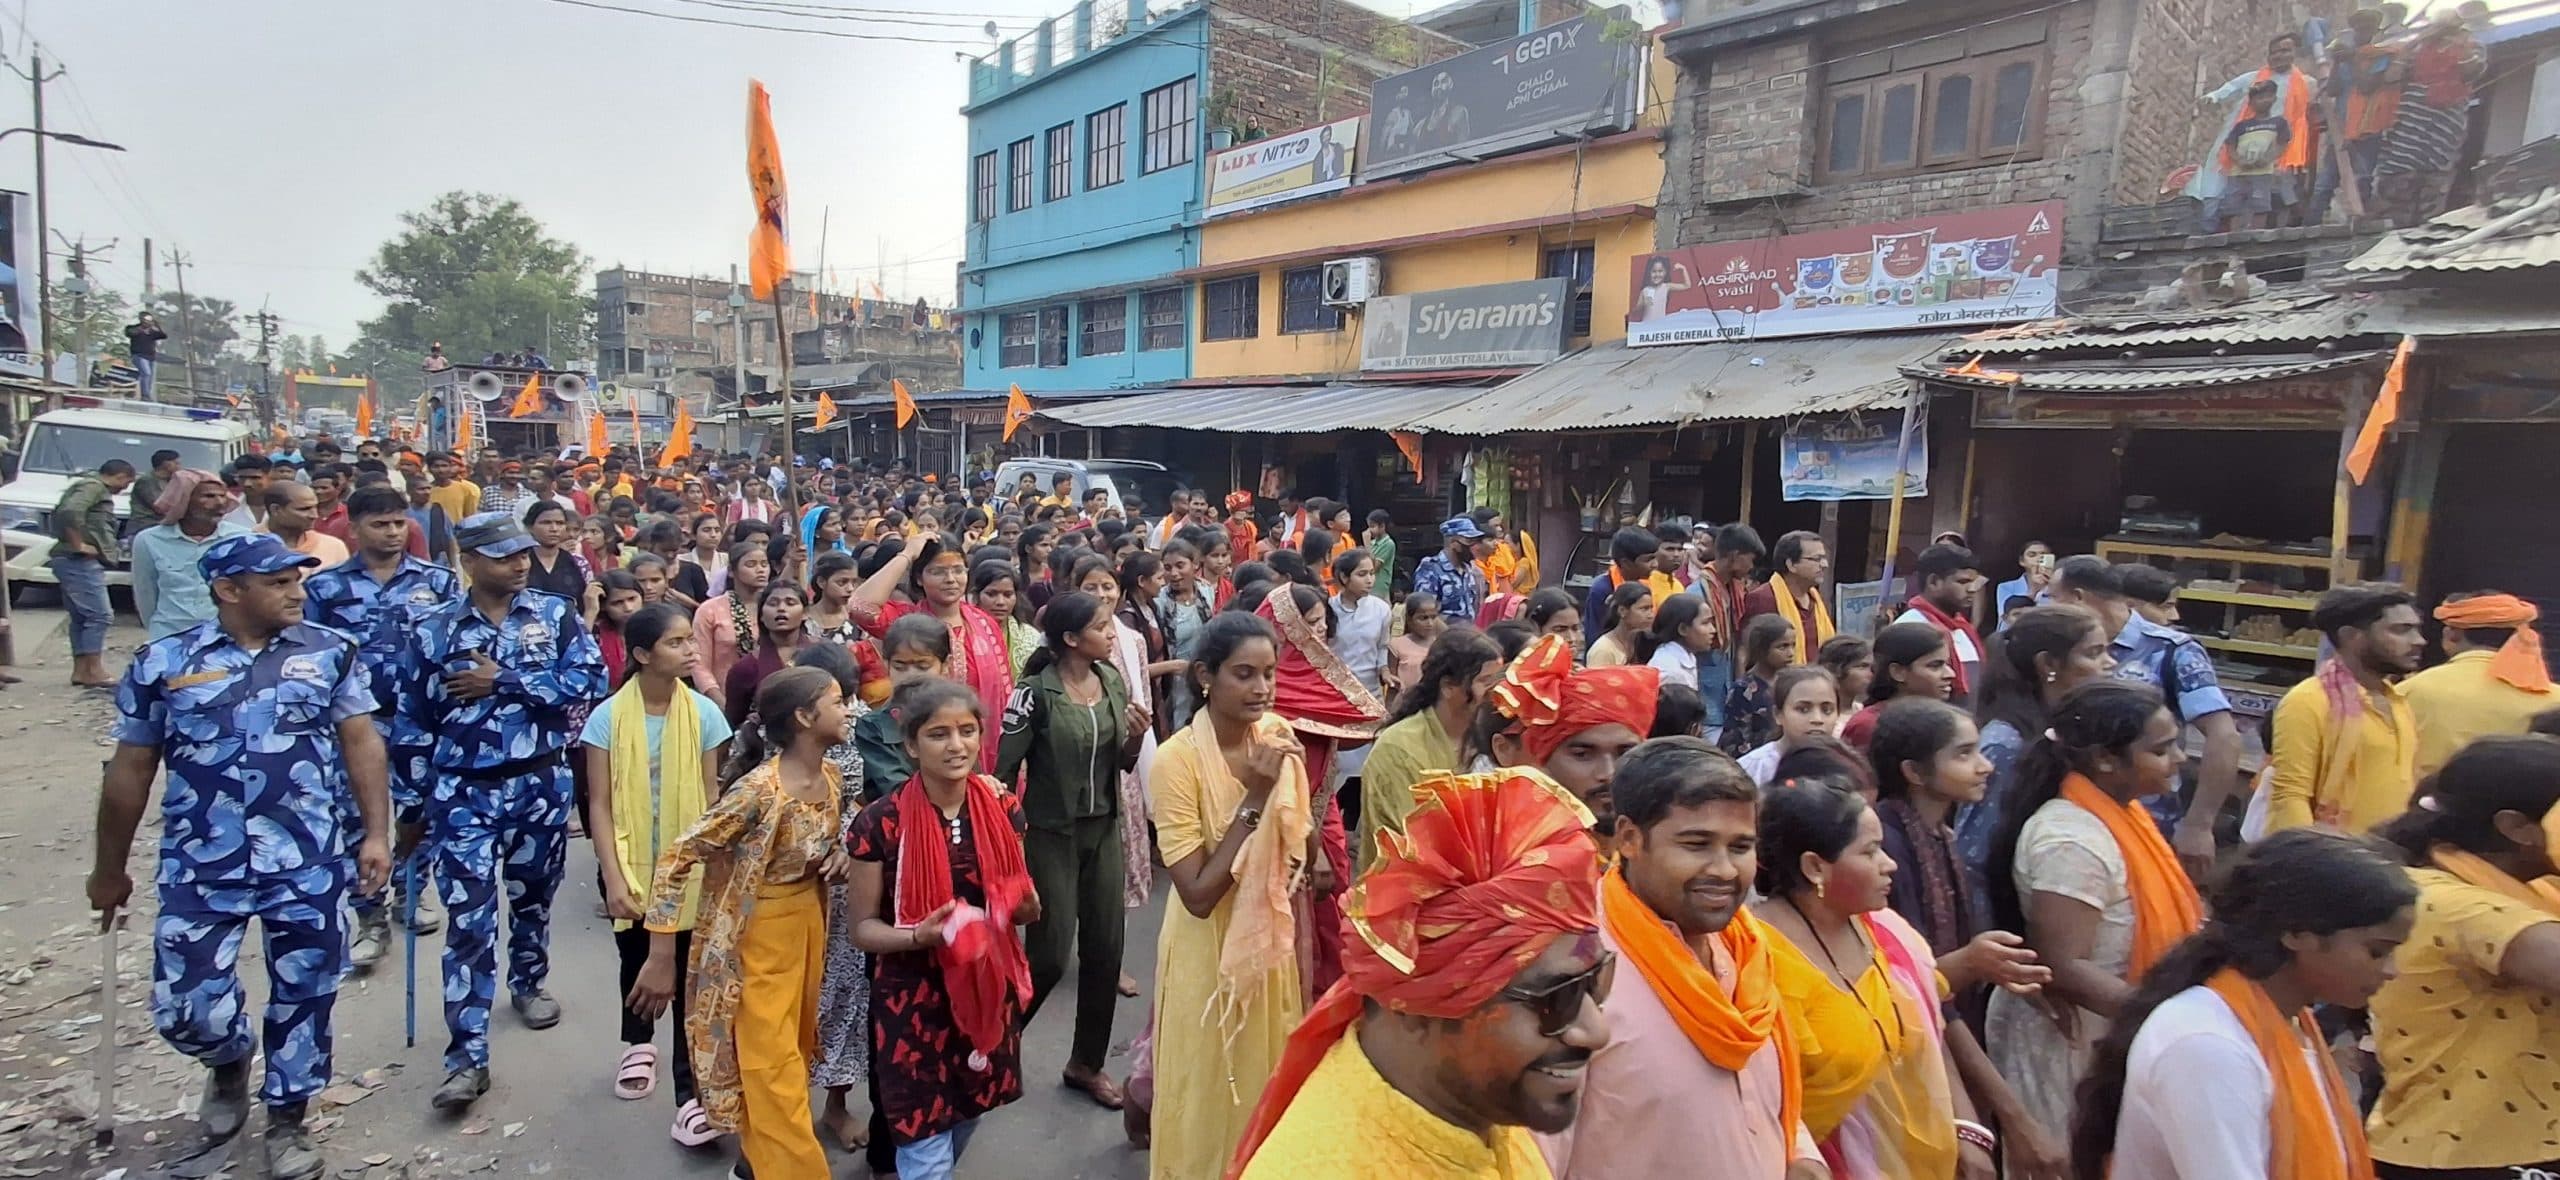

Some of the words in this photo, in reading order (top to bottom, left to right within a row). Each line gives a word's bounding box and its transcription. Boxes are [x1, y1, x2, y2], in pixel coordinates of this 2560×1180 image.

[1517, 69, 1554, 94] CHALO
[1505, 91, 1531, 112] APNI
[1532, 76, 1569, 100] CHAAL
[1221, 151, 1257, 173] LUX
[1697, 268, 1777, 287] AASHIRVAAD
[1717, 283, 1754, 298] svasti
[1416, 293, 1556, 340] Siyaram's
[1639, 331, 1671, 343] RAJESH
[1674, 328, 1713, 341] GENERAL
[1716, 326, 1746, 339] STORE
[1394, 355, 1437, 367] SATYAM
[1438, 352, 1511, 365] VASTRALAYA
